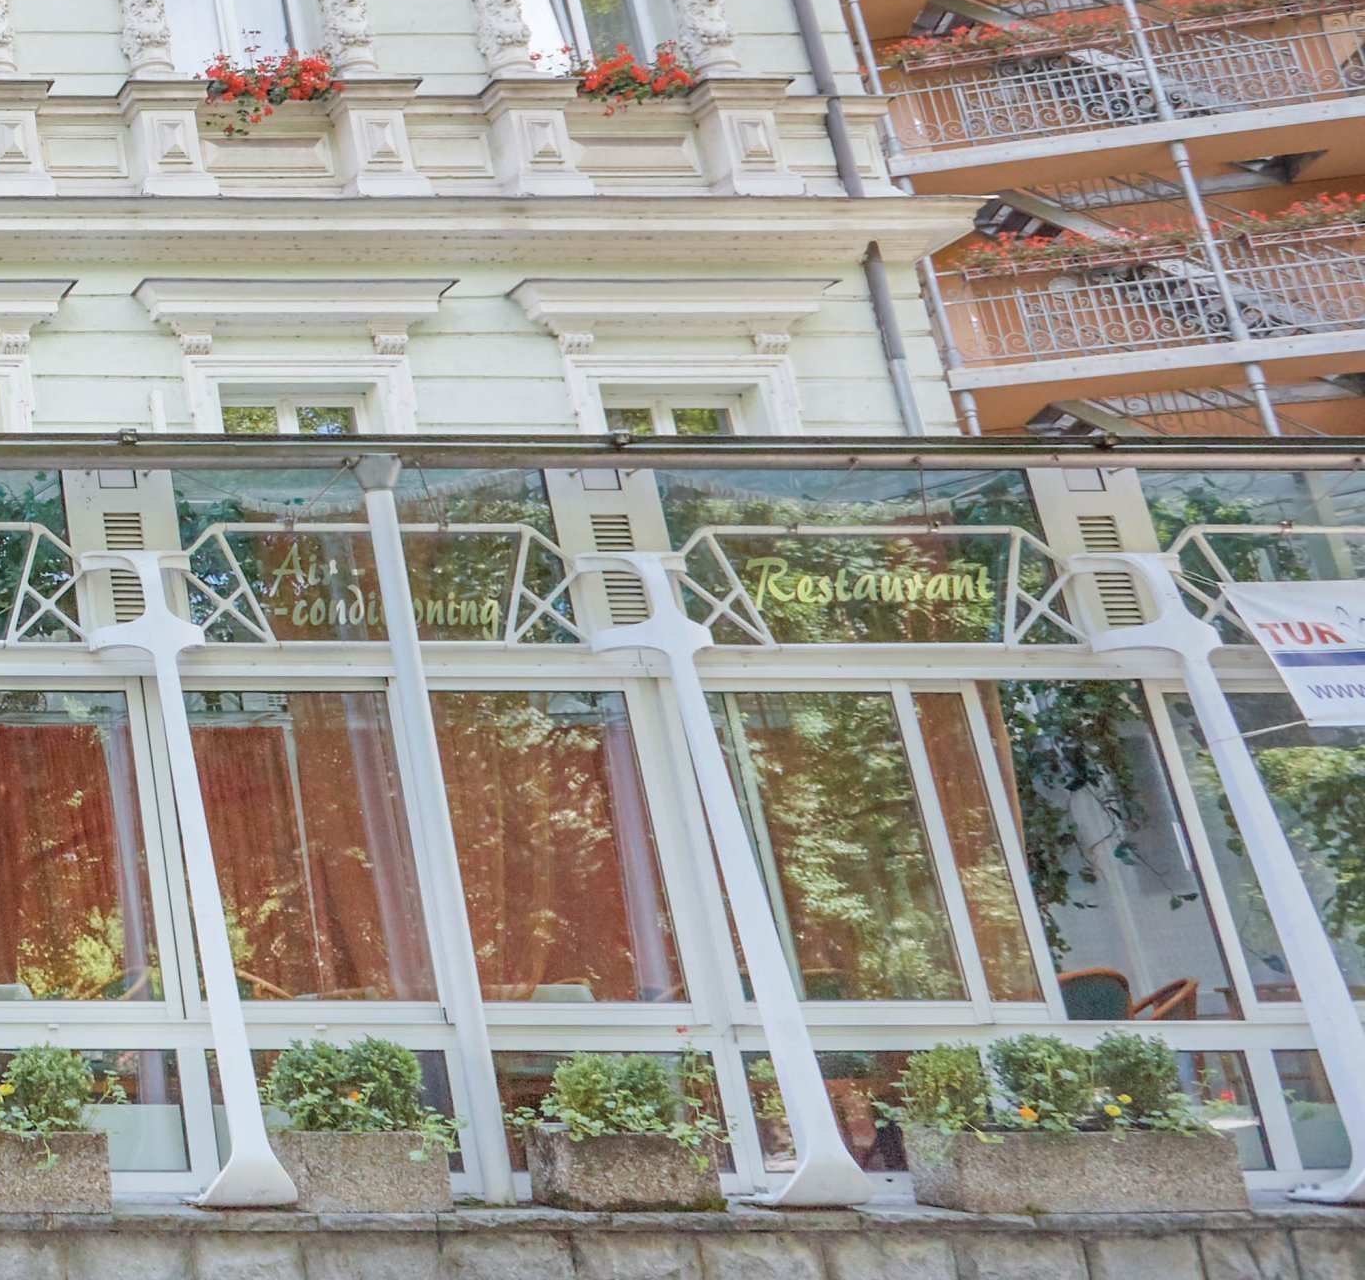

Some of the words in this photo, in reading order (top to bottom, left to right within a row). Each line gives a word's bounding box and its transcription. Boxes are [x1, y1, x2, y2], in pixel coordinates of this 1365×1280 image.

[269, 542, 338, 597] Air
[745, 557, 995, 611] Restaurant
[274, 584, 500, 641] -condioning
